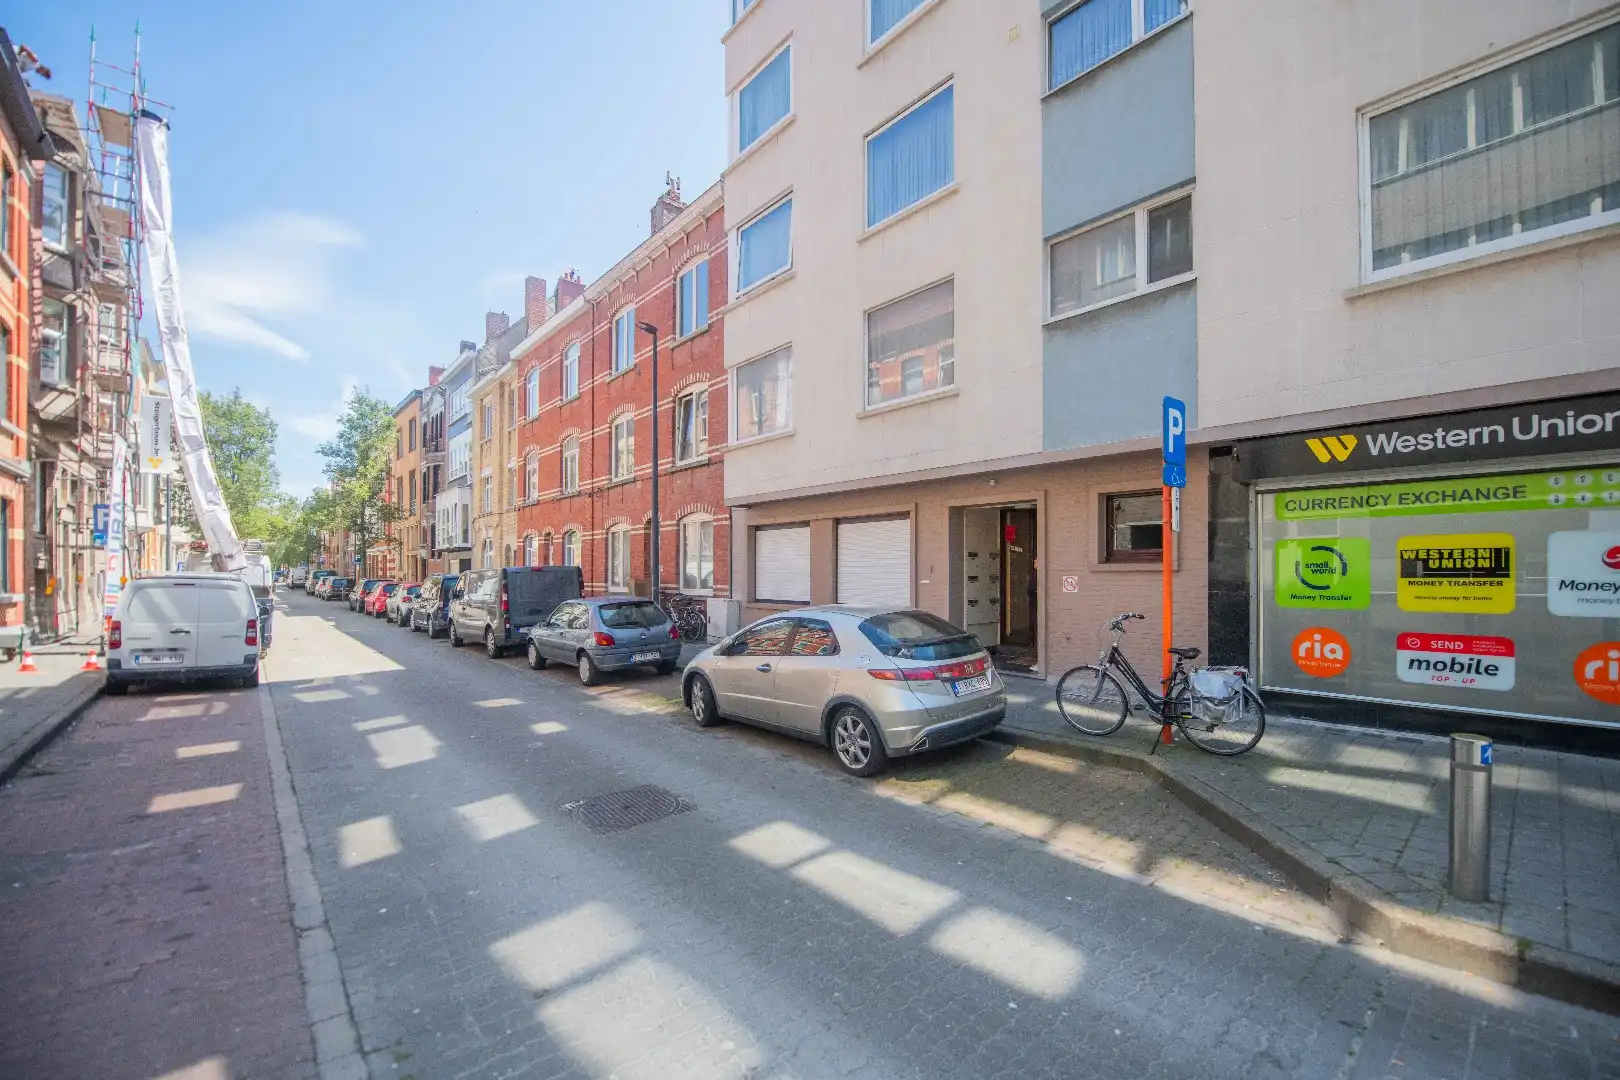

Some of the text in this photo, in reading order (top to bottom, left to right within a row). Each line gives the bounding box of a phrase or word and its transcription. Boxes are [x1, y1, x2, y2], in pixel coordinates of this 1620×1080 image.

[1168, 407, 1182, 453] P
[1365, 424, 1505, 456] Western
[1284, 485, 1528, 512] CURRENCY EXCHANGE
[1401, 548, 1490, 560] WESTERN
[1304, 561, 1329, 569] small
[1428, 558, 1490, 569] UNION
[1310, 566, 1337, 575] world
[1290, 593, 1317, 602] Money
[1298, 633, 1344, 660] ria
[1430, 640, 1464, 650] SEND
[1407, 656, 1500, 677] mobile
